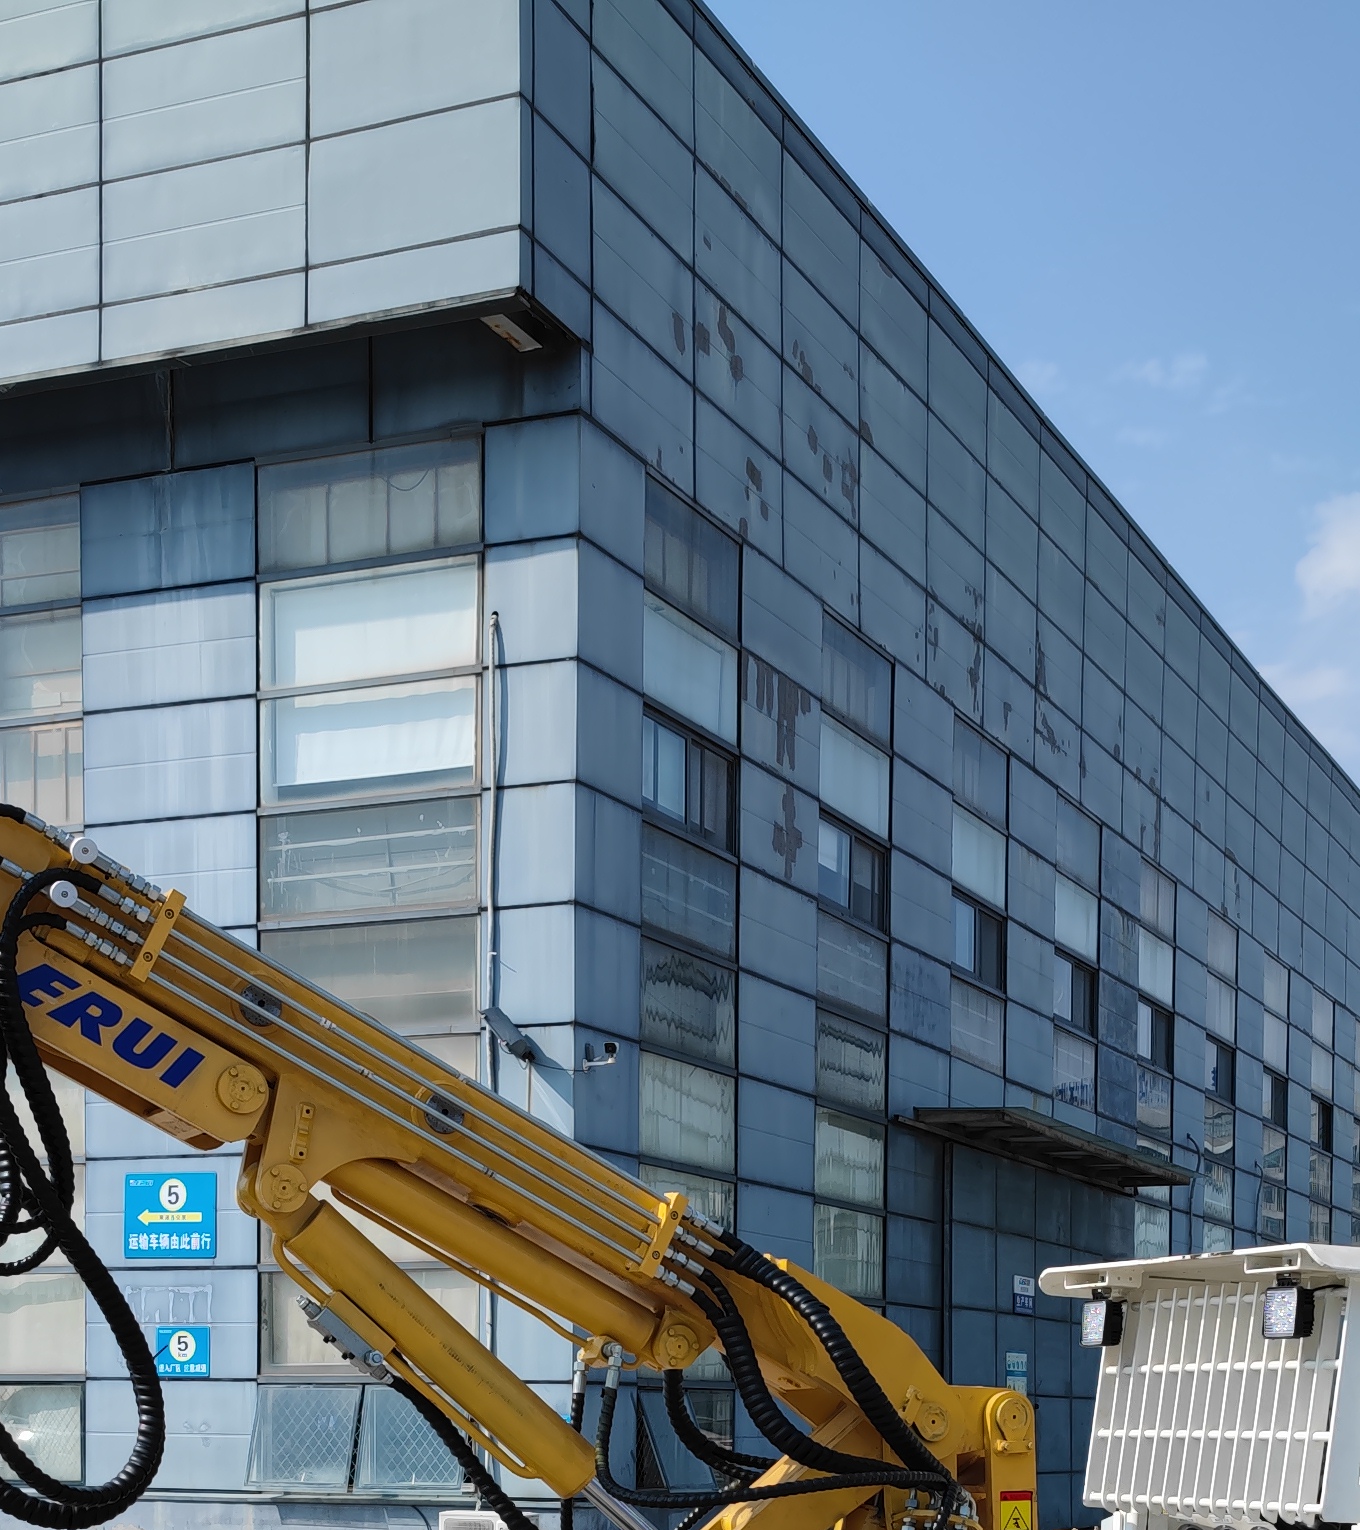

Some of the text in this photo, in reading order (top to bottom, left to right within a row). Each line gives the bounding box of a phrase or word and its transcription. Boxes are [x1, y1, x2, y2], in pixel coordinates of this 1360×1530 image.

[168, 1185, 179, 1205] 5
[128, 1232, 212, 1251] 运输车辆由此前行
[177, 1335, 189, 1352] 5
